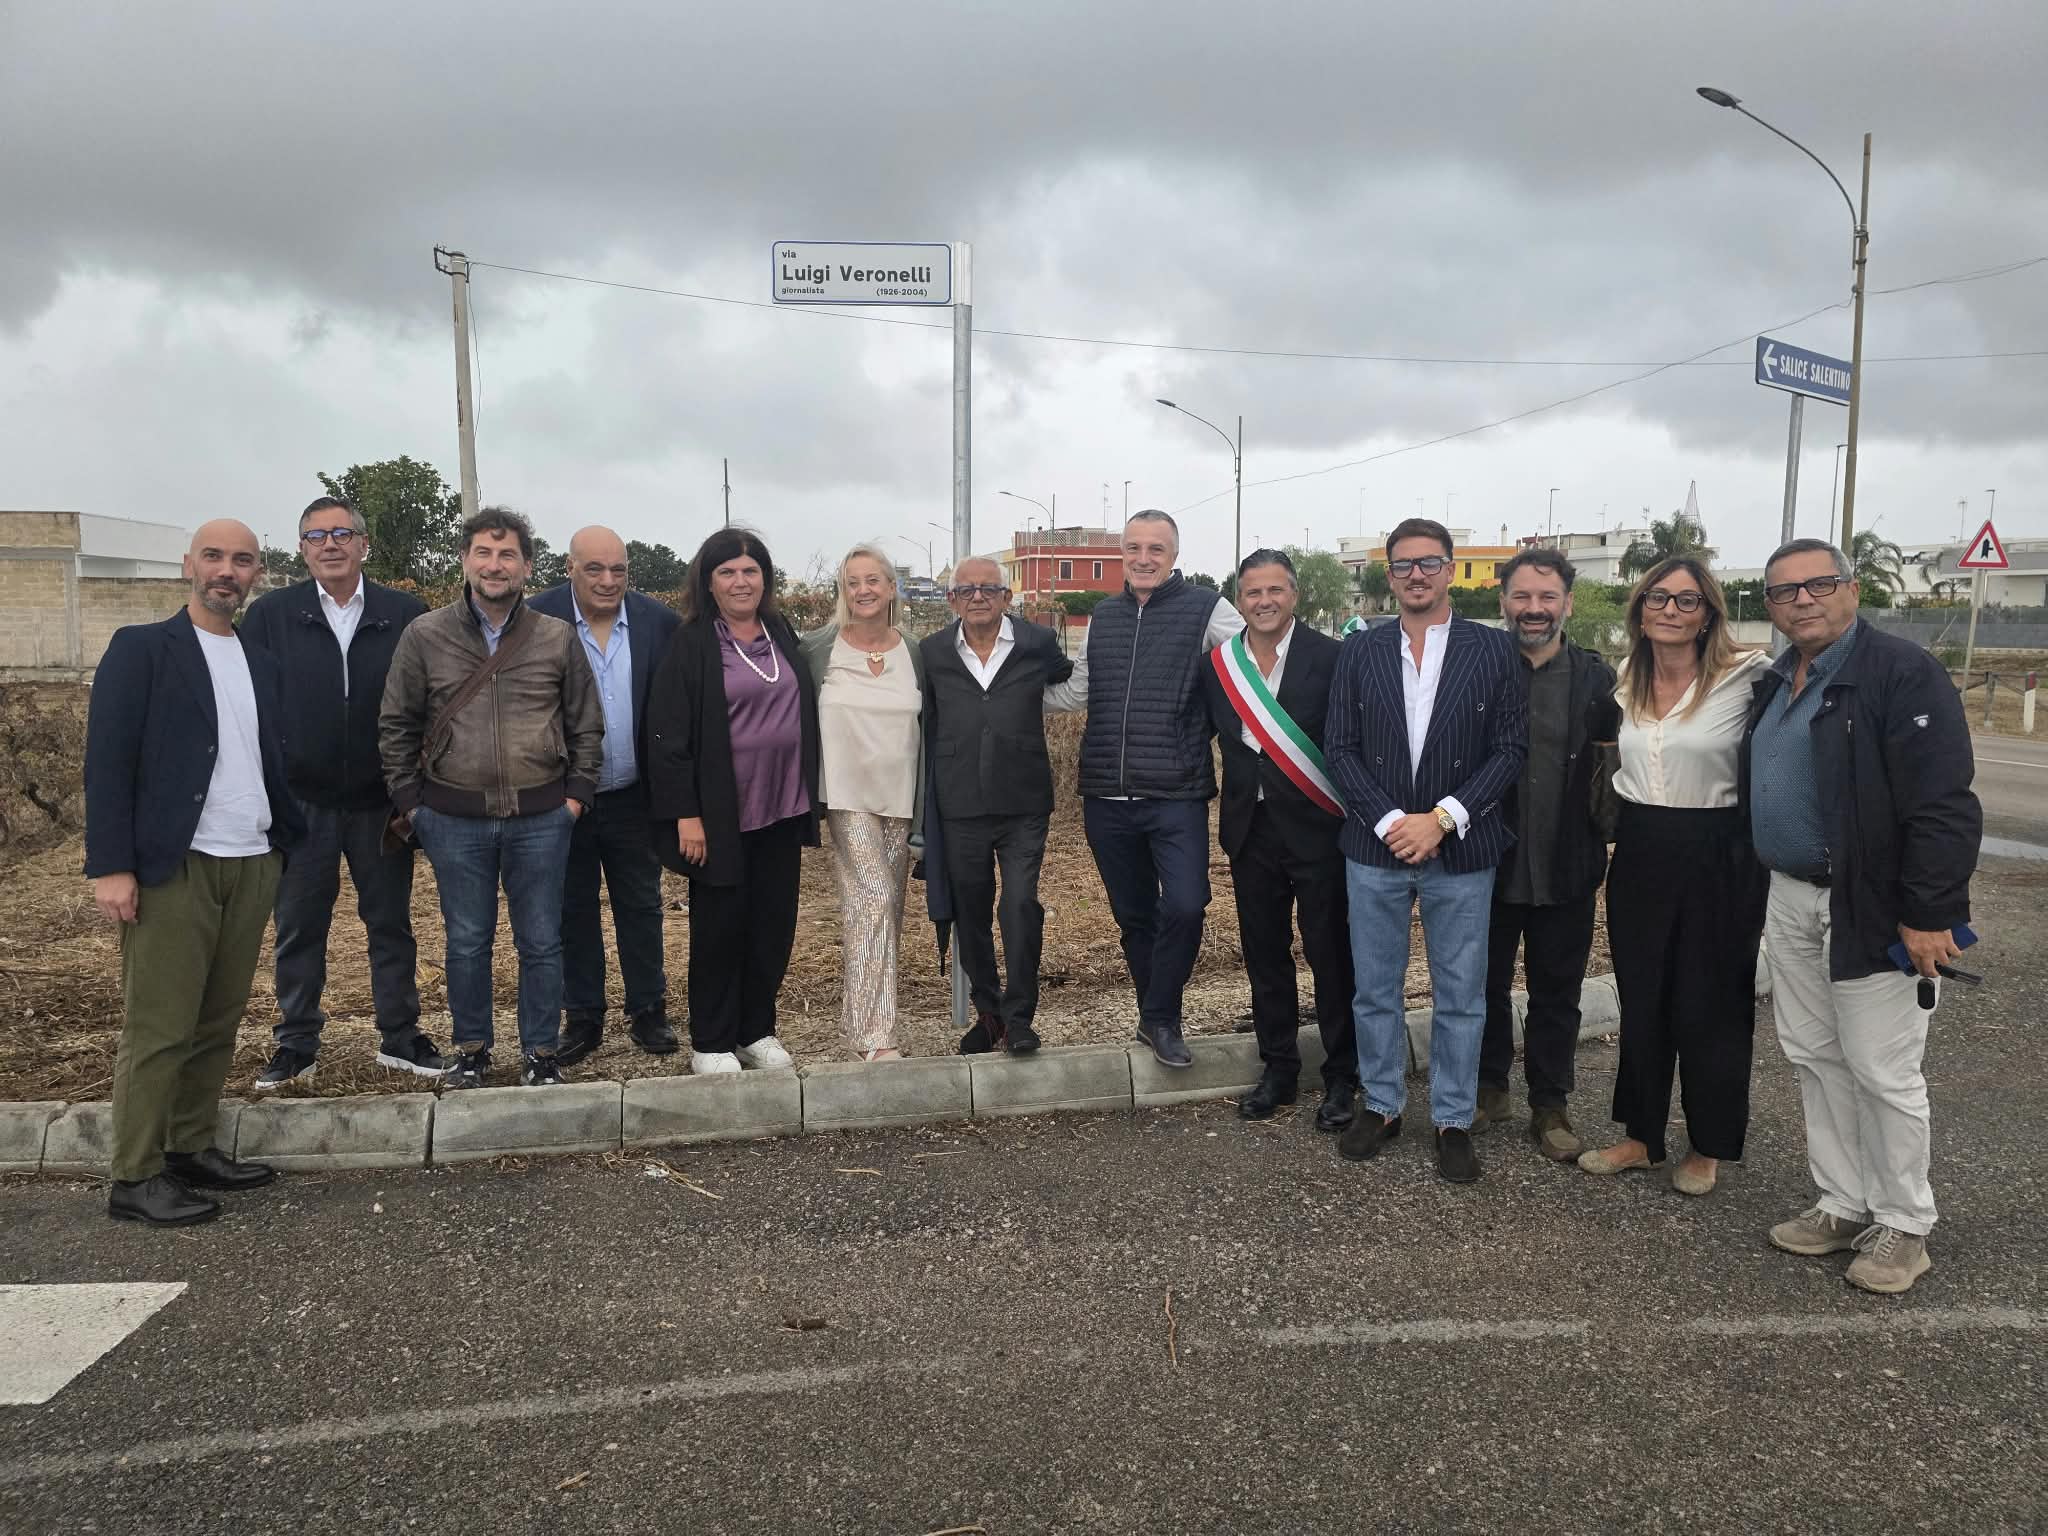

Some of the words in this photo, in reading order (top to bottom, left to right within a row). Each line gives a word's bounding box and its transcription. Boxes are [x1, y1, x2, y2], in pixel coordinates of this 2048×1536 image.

[782, 249, 797, 259] via
[782, 264, 830, 284] Luigi
[839, 265, 931, 283] Veronelli
[781, 286, 825, 295] giornalista
[876, 288, 928, 297] (1926-2004)
[1780, 354, 1808, 380] SALICE
[1810, 363, 1851, 391] SALENTINO
